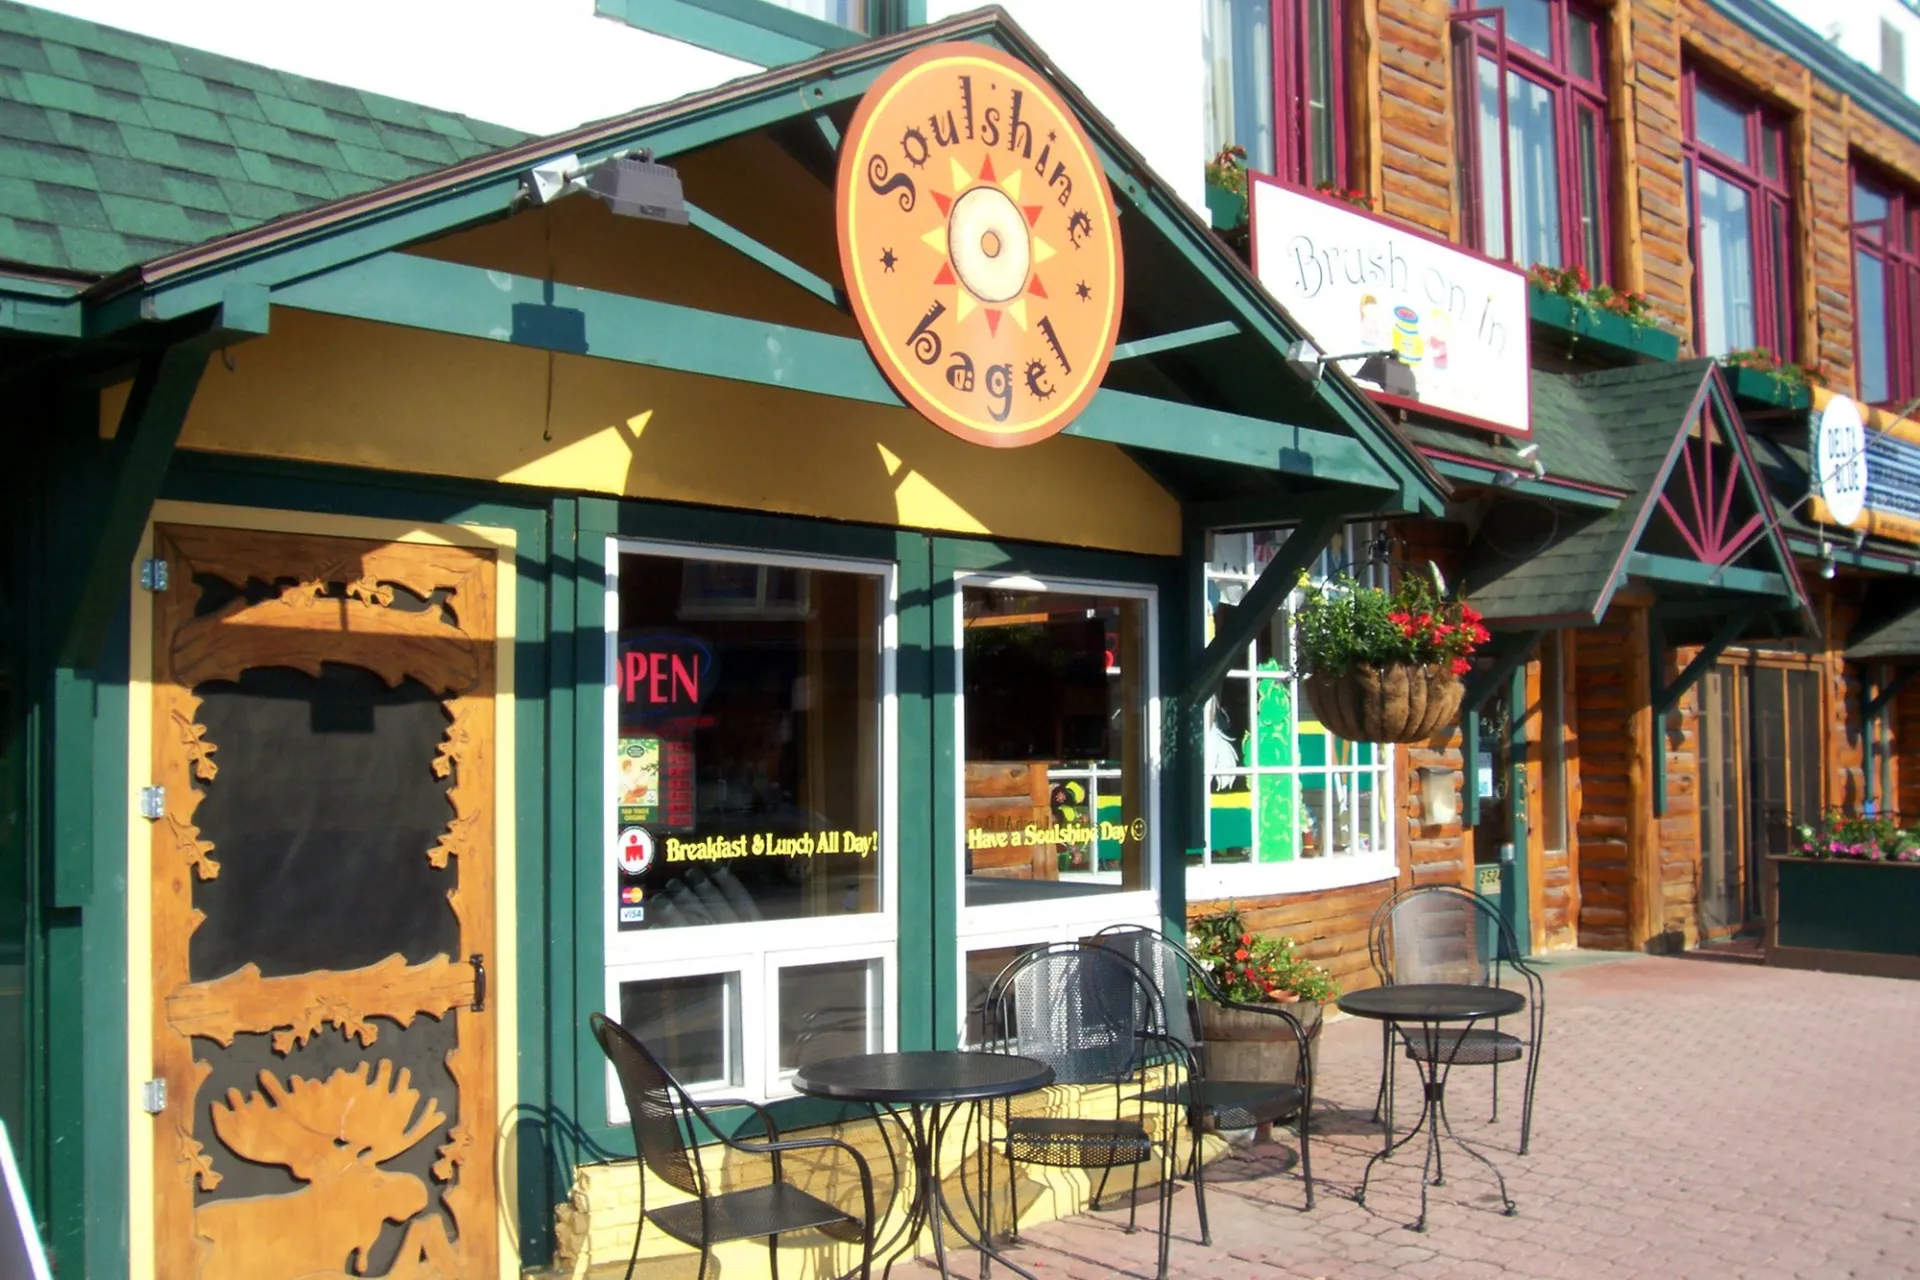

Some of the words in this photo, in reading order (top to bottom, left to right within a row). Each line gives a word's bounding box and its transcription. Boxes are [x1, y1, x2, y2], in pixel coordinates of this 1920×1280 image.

[867, 75, 1094, 250] Soulshine
[1286, 234, 1409, 299] Brush
[906, 300, 1072, 422] bagel
[666, 835, 748, 862] Breakfast
[751, 833, 765, 856] &
[765, 832, 814, 858] Lunch
[816, 831, 839, 854] All
[843, 831, 878, 858] Day!
[967, 827, 1008, 850] Have
[1011, 830, 1021, 847] a
[1024, 822, 1098, 846] Soulshine
[1100, 820, 1128, 844] Day
[623, 909, 642, 919] VISA
